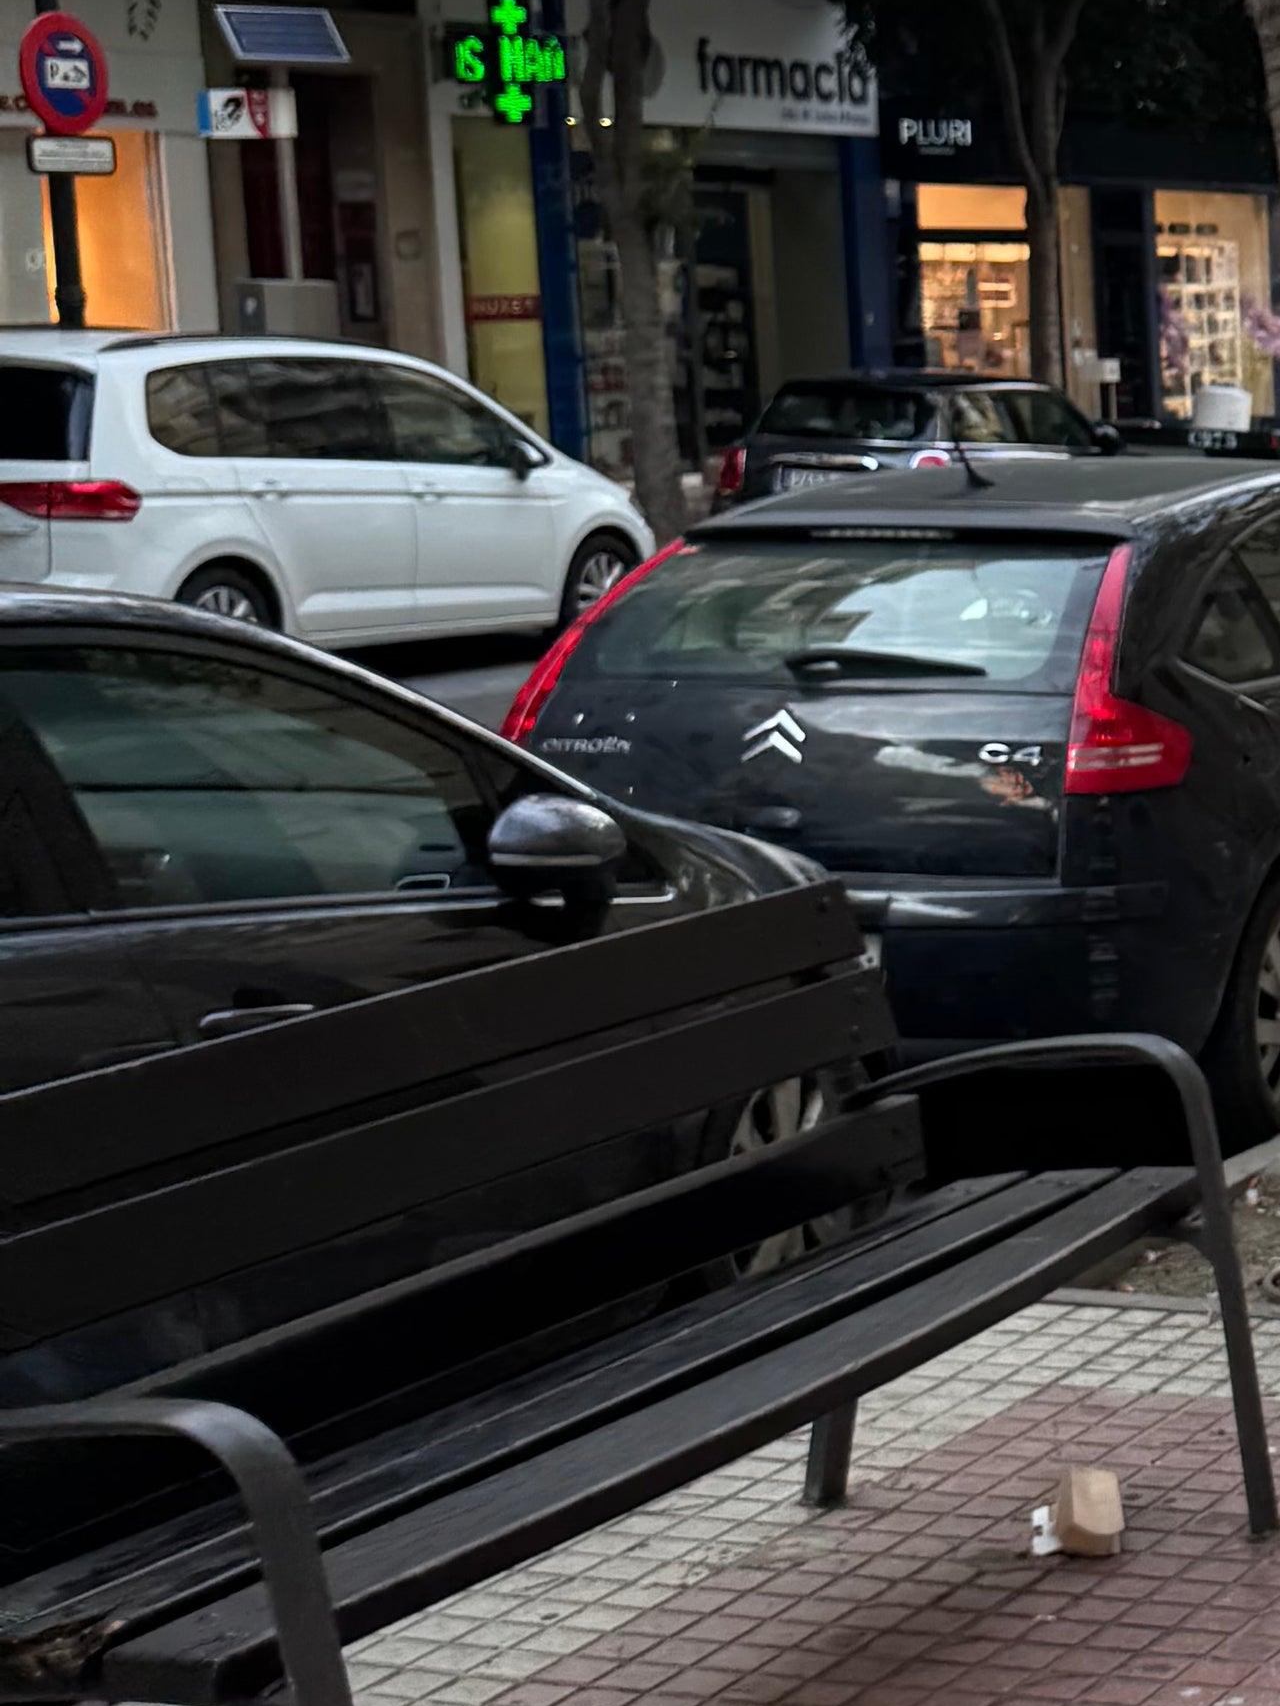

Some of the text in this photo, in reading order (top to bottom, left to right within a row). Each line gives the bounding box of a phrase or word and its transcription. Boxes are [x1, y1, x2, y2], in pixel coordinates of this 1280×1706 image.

[697, 37, 869, 106] farmacia
[899, 117, 972, 147] PLURI
[979, 742, 1042, 766] C4
